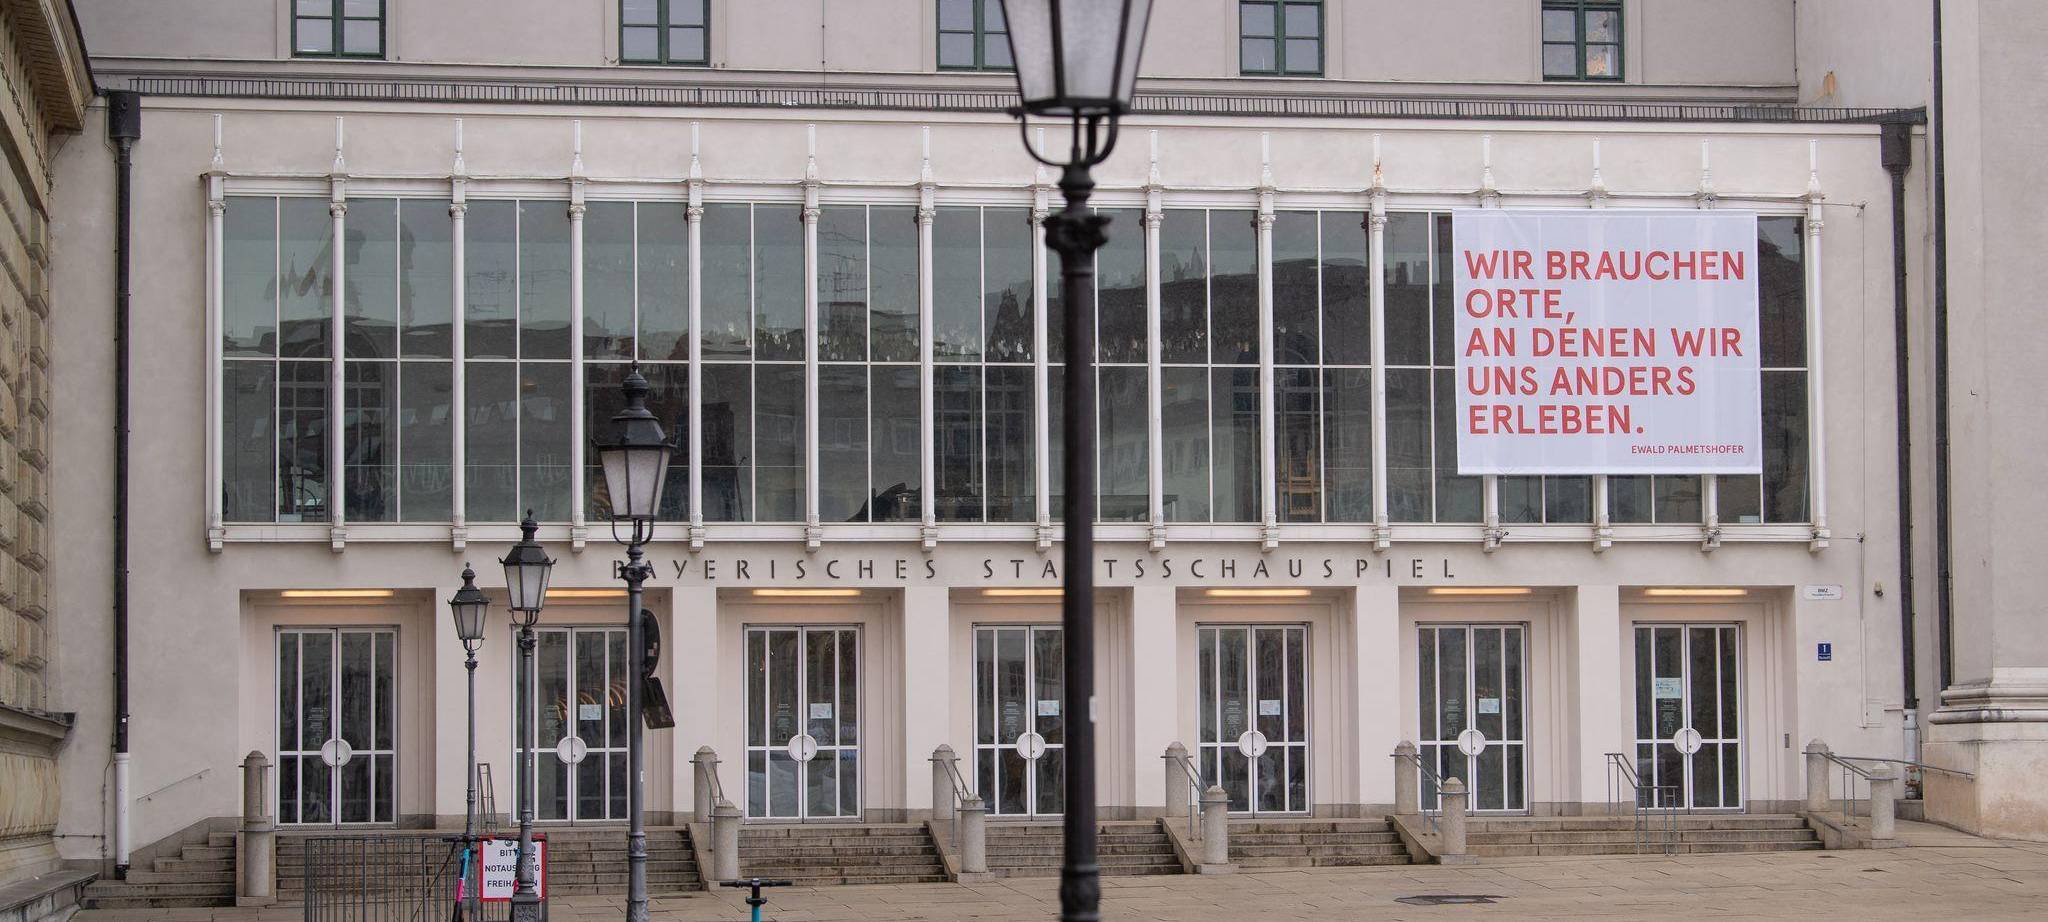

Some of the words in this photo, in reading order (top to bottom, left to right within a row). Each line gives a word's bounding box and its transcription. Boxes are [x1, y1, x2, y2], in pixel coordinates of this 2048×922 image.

[1464, 250, 1535, 280] WIR
[1546, 250, 1744, 281] BRAUCHEN
[1465, 288, 1575, 325] ORTE,
[1465, 327, 1516, 357] AN
[1532, 327, 1656, 357] DENEN
[1670, 327, 1743, 357] WIR
[1467, 366, 1538, 396] UNS
[1550, 366, 1696, 396] ANDERS
[1469, 404, 1644, 434] ERLEBEN.
[1631, 445, 1665, 454] EWALD
[1668, 445, 1744, 454] PALMETSHOFER
[983, 558, 1454, 579] STATSSCHAUSPIEL
[485, 864, 540, 872] NOTAUSG
